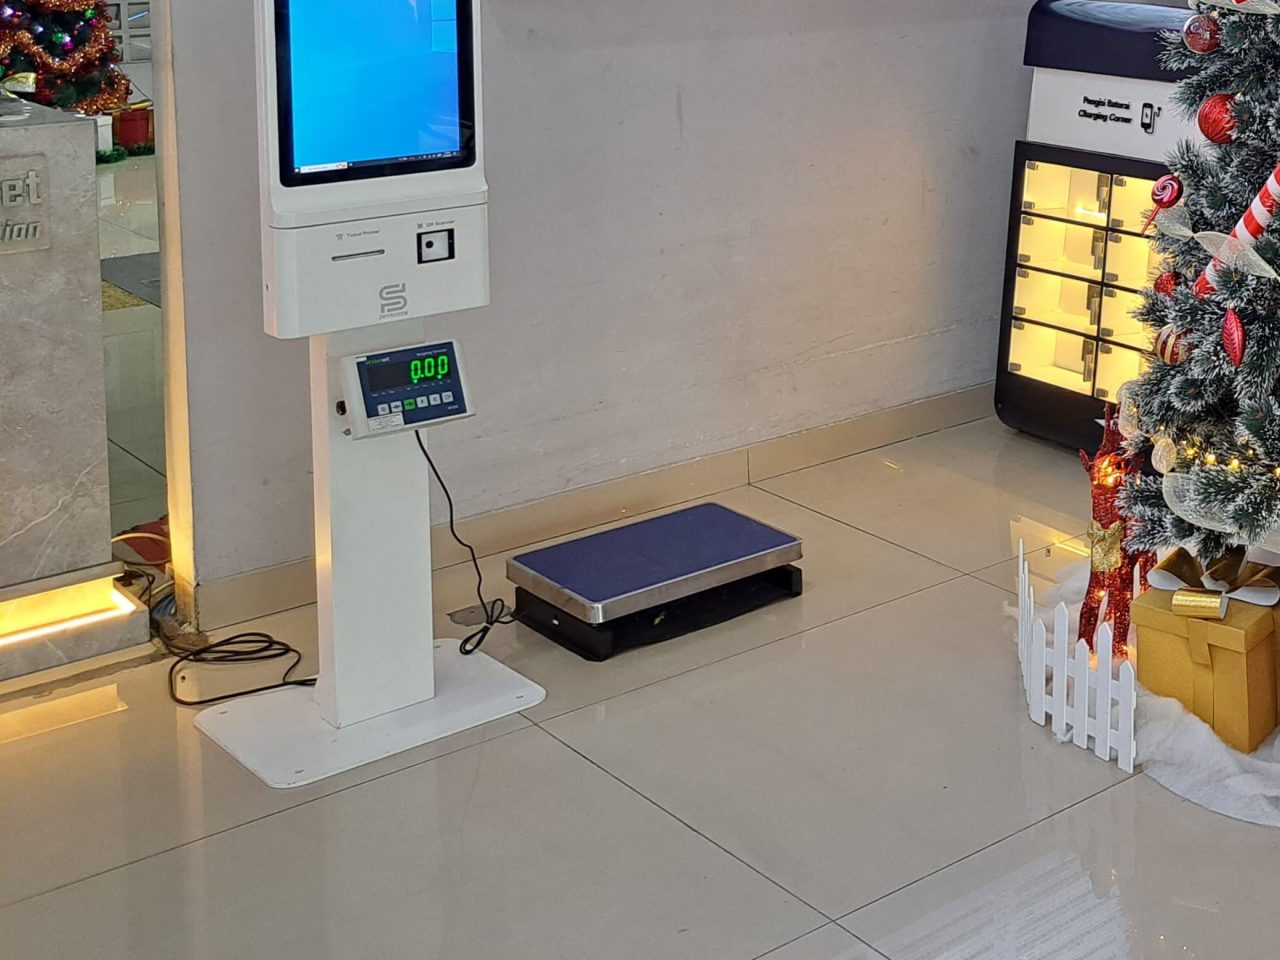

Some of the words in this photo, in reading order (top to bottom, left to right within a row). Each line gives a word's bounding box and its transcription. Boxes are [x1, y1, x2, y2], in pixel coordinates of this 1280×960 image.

[1083, 96, 1106, 108] Pengisi
[1078, 109, 1108, 122] Charging
[1109, 113, 1132, 124] Corner
[411, 355, 449, 380] 0.00
